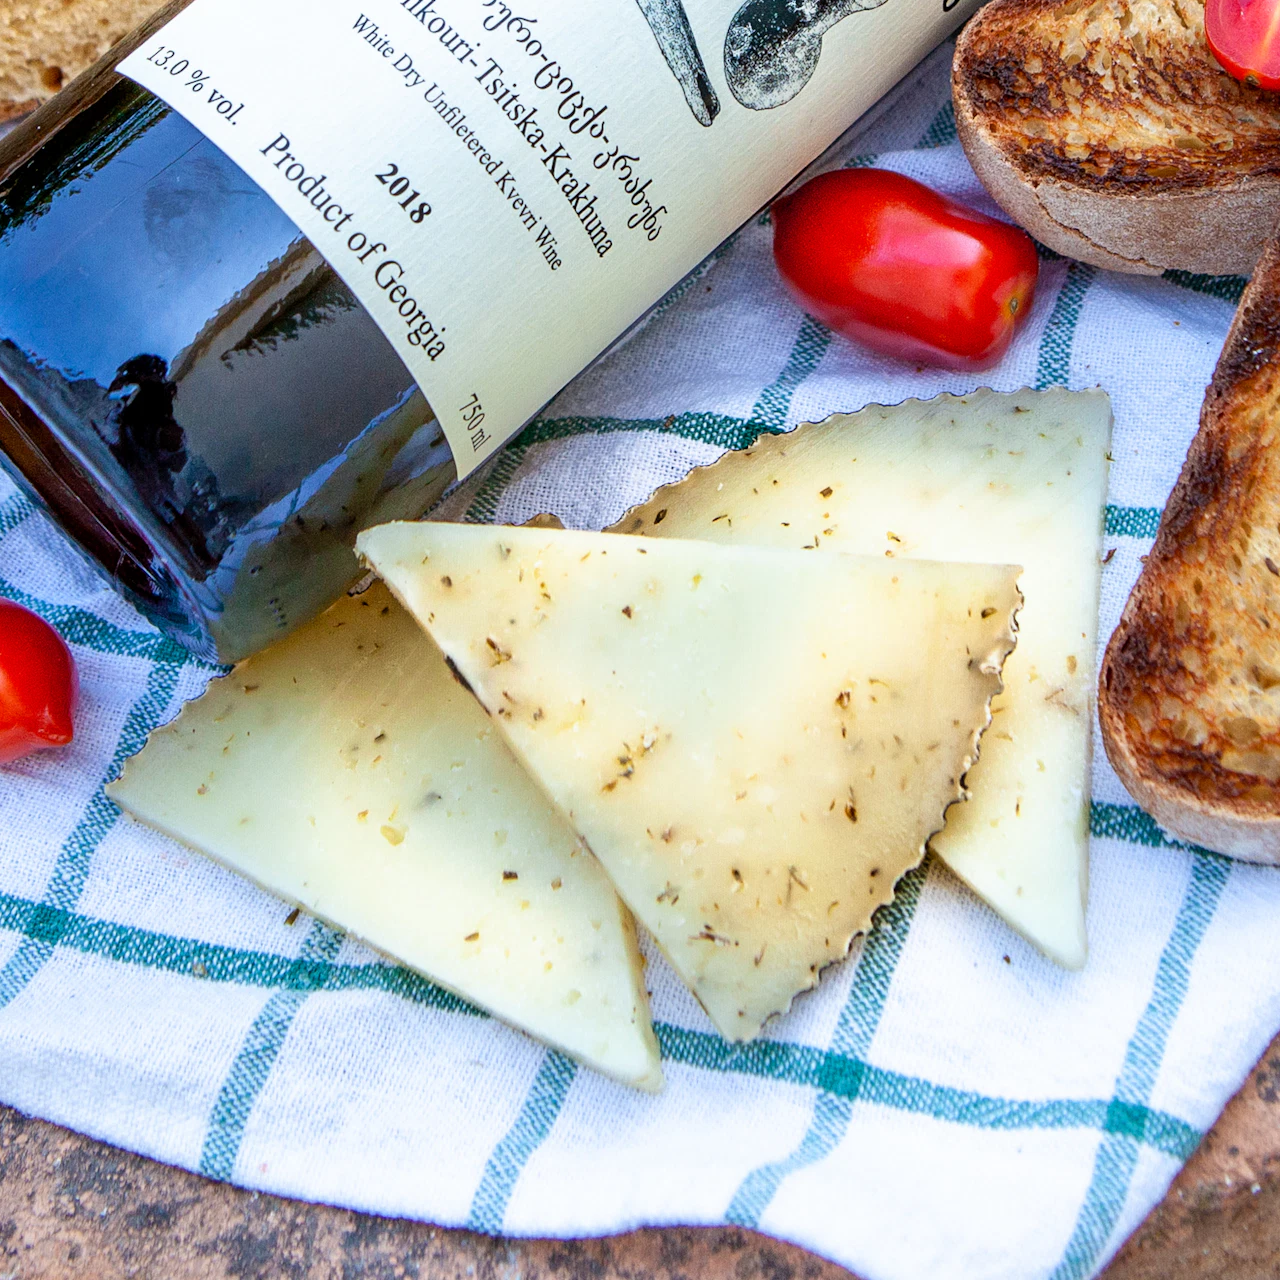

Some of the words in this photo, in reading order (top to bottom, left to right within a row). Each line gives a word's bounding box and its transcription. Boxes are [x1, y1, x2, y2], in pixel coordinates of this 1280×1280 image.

[146, 45, 190, 76] 13.0
[184, 68, 210, 93] %
[206, 88, 245, 126] vol.
[351, 13, 395, 58] White
[391, 52, 425, 87] Dry
[423, 82, 504, 176] Unfiletered
[494, 169, 538, 231] Kvevri
[534, 223, 562, 271] Wine
[373, 162, 432, 224] 2018
[260, 132, 353, 232] Product
[346, 231, 387, 263] of
[373, 259, 446, 362] Georgia
[458, 391, 485, 431] 750
[469, 427, 492, 452] ml
